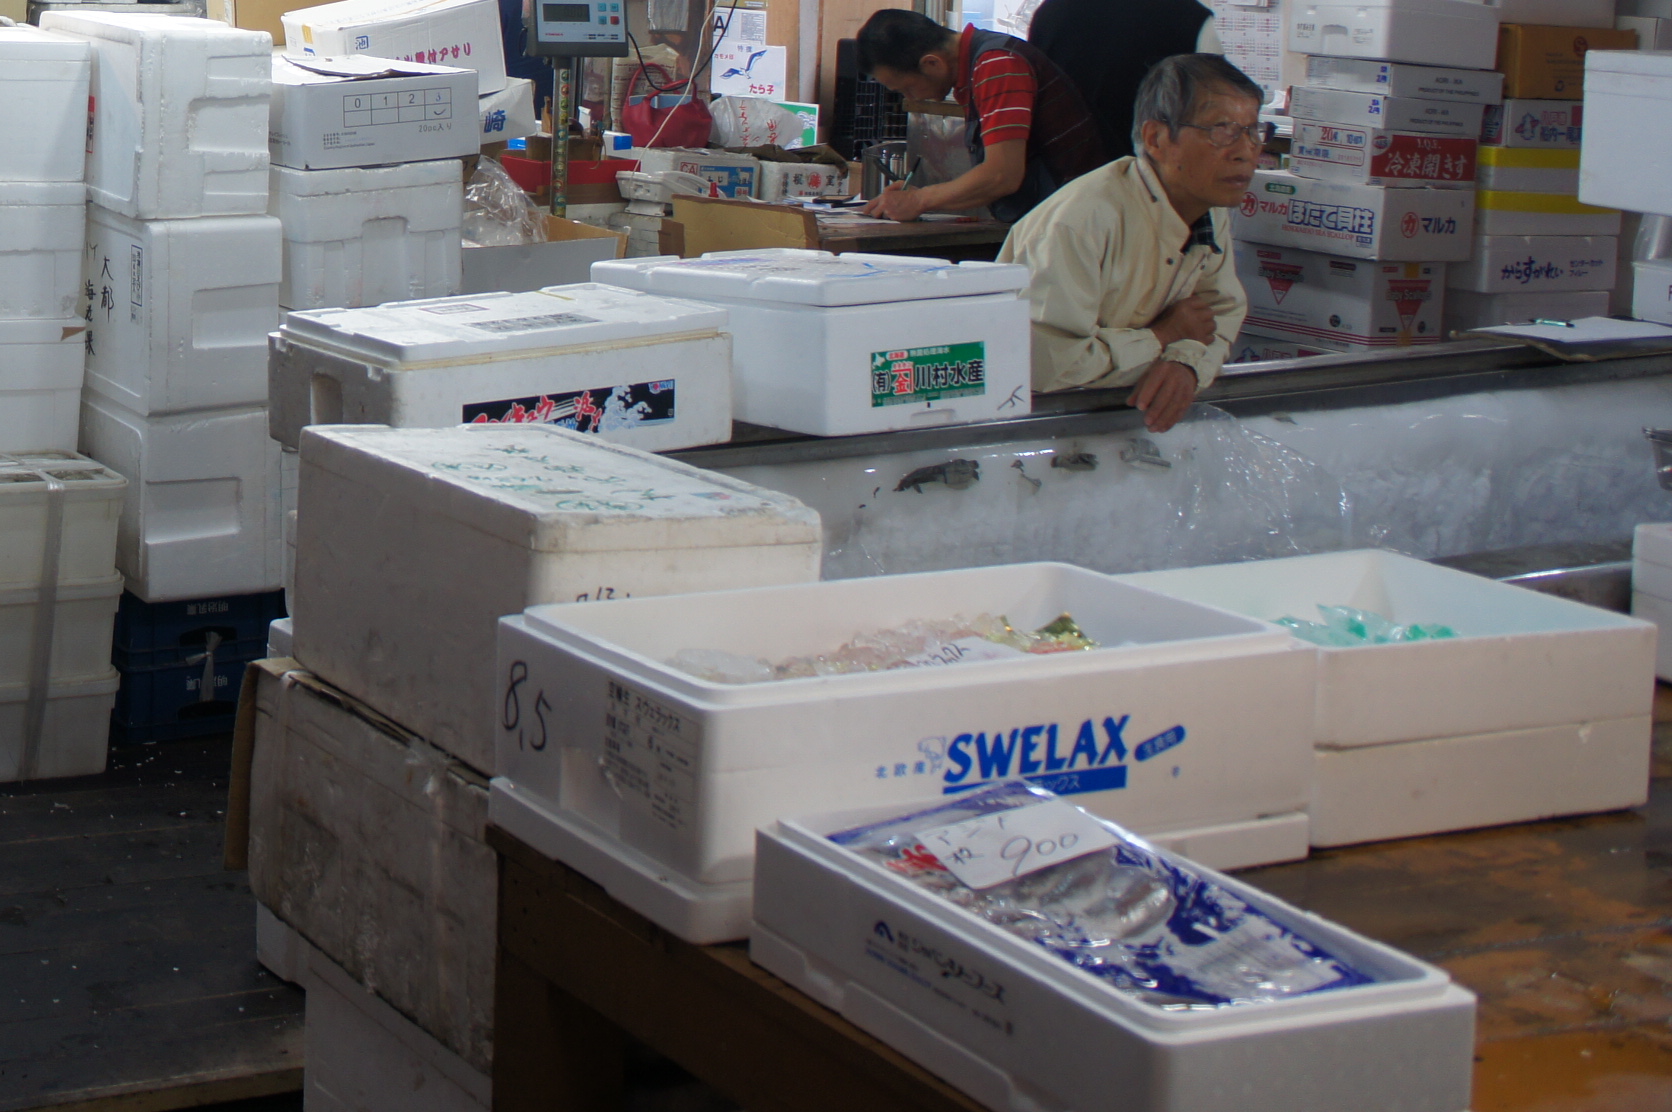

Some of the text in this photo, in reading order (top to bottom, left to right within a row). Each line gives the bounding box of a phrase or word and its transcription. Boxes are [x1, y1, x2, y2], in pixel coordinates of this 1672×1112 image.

[354, 98, 362, 109] 0
[383, 96, 389, 107] 1
[408, 94, 415, 105] 2
[749, 83, 776, 96] たら子
[484, 109, 507, 134] 崎
[1258, 200, 1288, 216] マルカ
[1287, 198, 1375, 235] ほたて貝柱
[1421, 217, 1456, 234] マルカ
[915, 359, 985, 391] 川村水産
[942, 714, 1131, 785] SWELAX
[874, 760, 927, 780] 北欧産
[1000, 833, 1081, 878] 900
